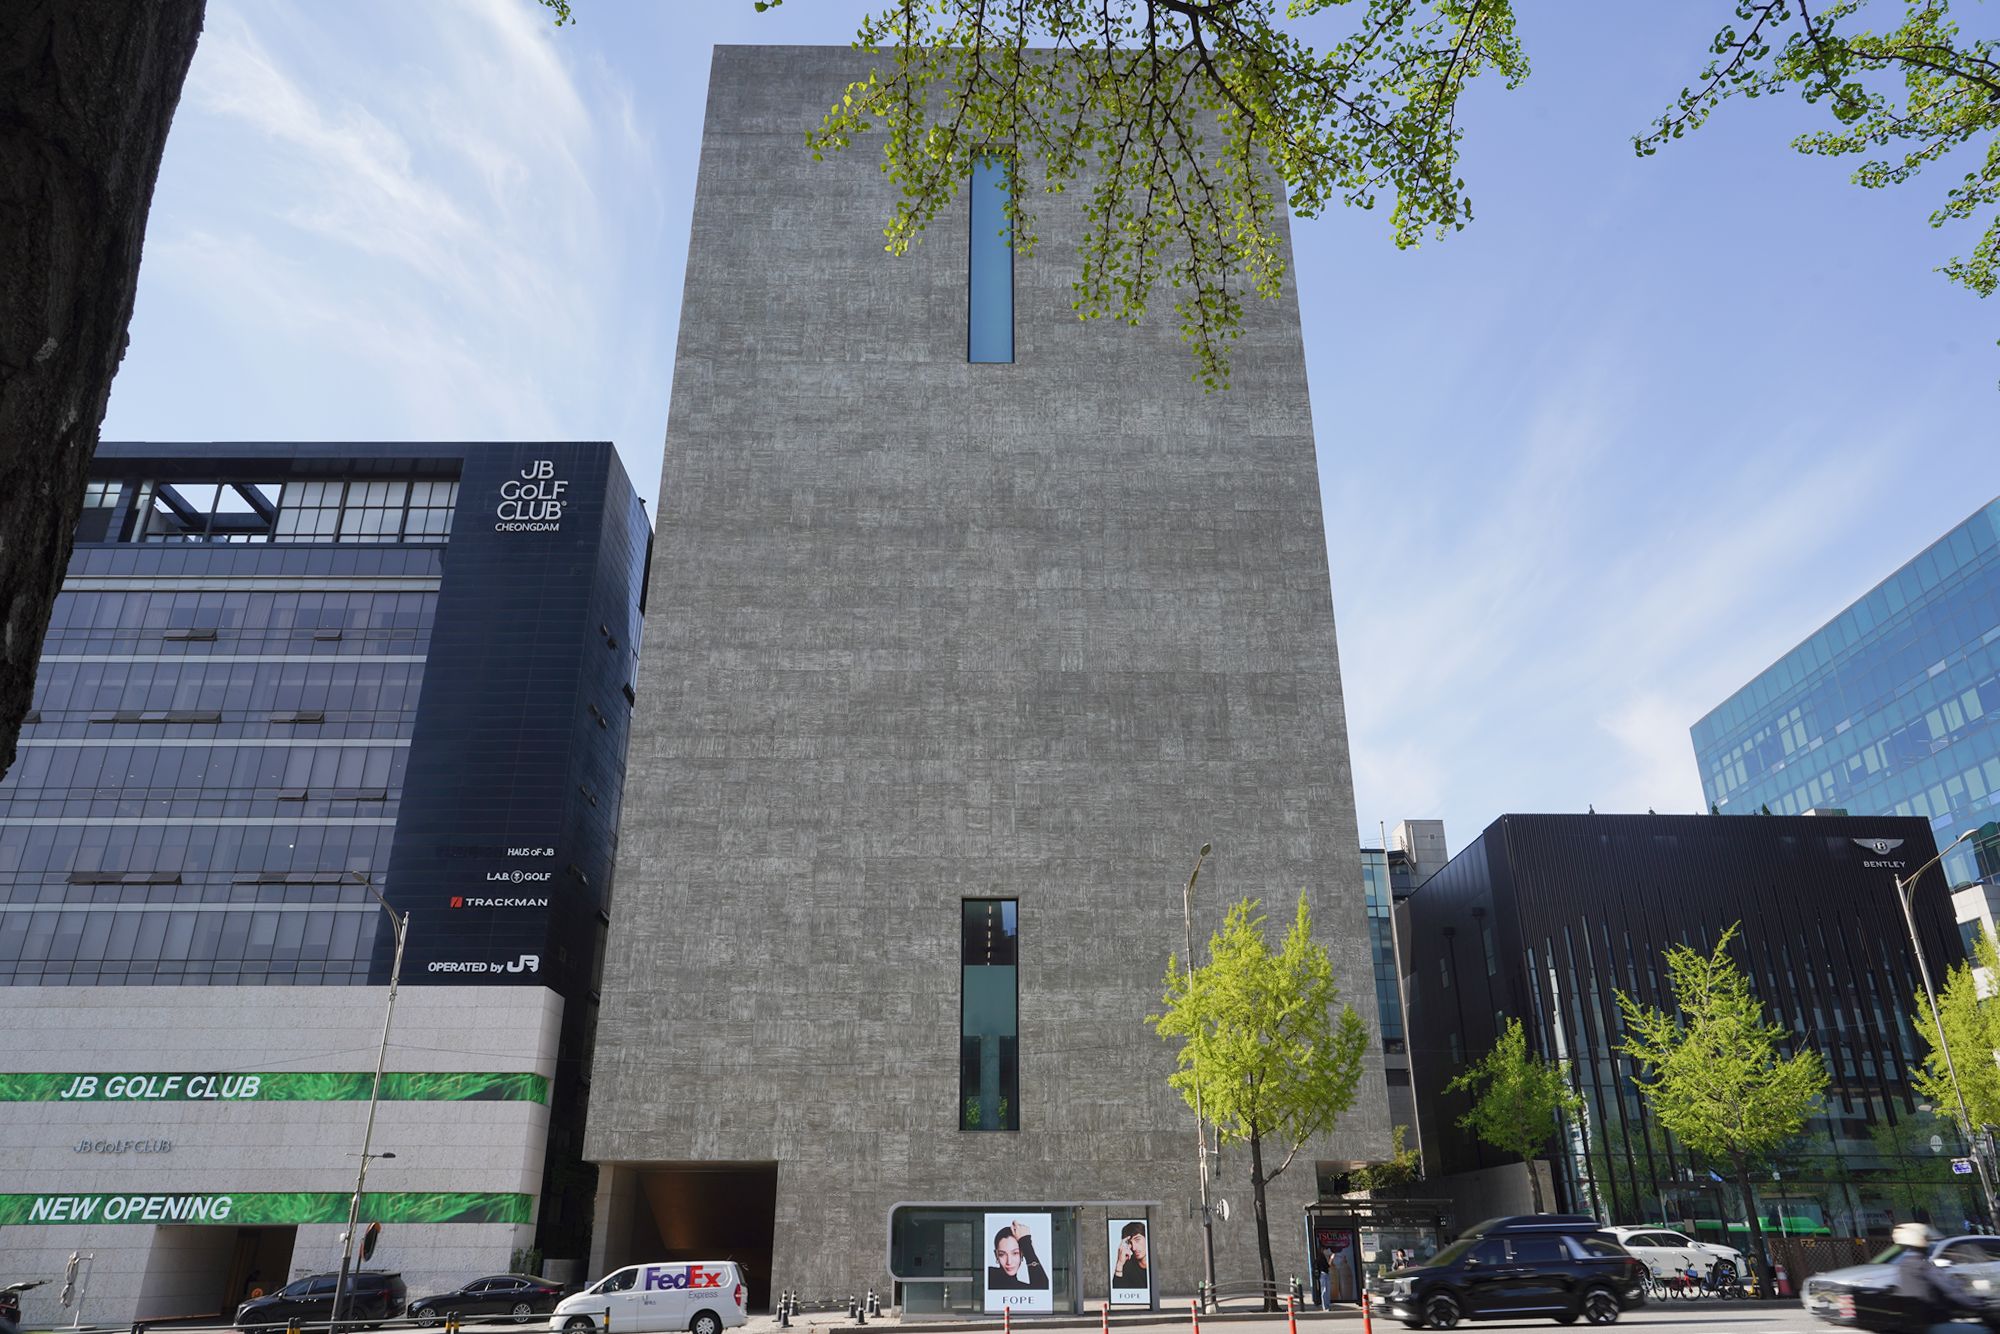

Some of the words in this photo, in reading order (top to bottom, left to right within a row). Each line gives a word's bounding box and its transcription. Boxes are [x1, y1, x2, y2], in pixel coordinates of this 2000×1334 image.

[520, 460, 554, 479] JB
[494, 522, 560, 532] CHEONGDAM
[507, 848, 530, 856] HAUS
[542, 848, 555, 856] JB
[524, 872, 552, 881] GOLF
[465, 898, 548, 907] TRACKMAN
[427, 962, 487, 973] OPERATED
[490, 962, 505, 974] by
[60, 1076, 98, 1098] JB
[104, 1076, 183, 1098] GOLF
[186, 1076, 262, 1098] CLUB
[73, 1139, 93, 1153] JB
[134, 1139, 172, 1153] CLUB
[28, 1197, 102, 1221] NEW
[103, 1197, 233, 1220] OPENING
[645, 1265, 721, 1291] FedEx
[688, 1291, 718, 1299] Express
[1001, 1296, 1036, 1305] FOPE
